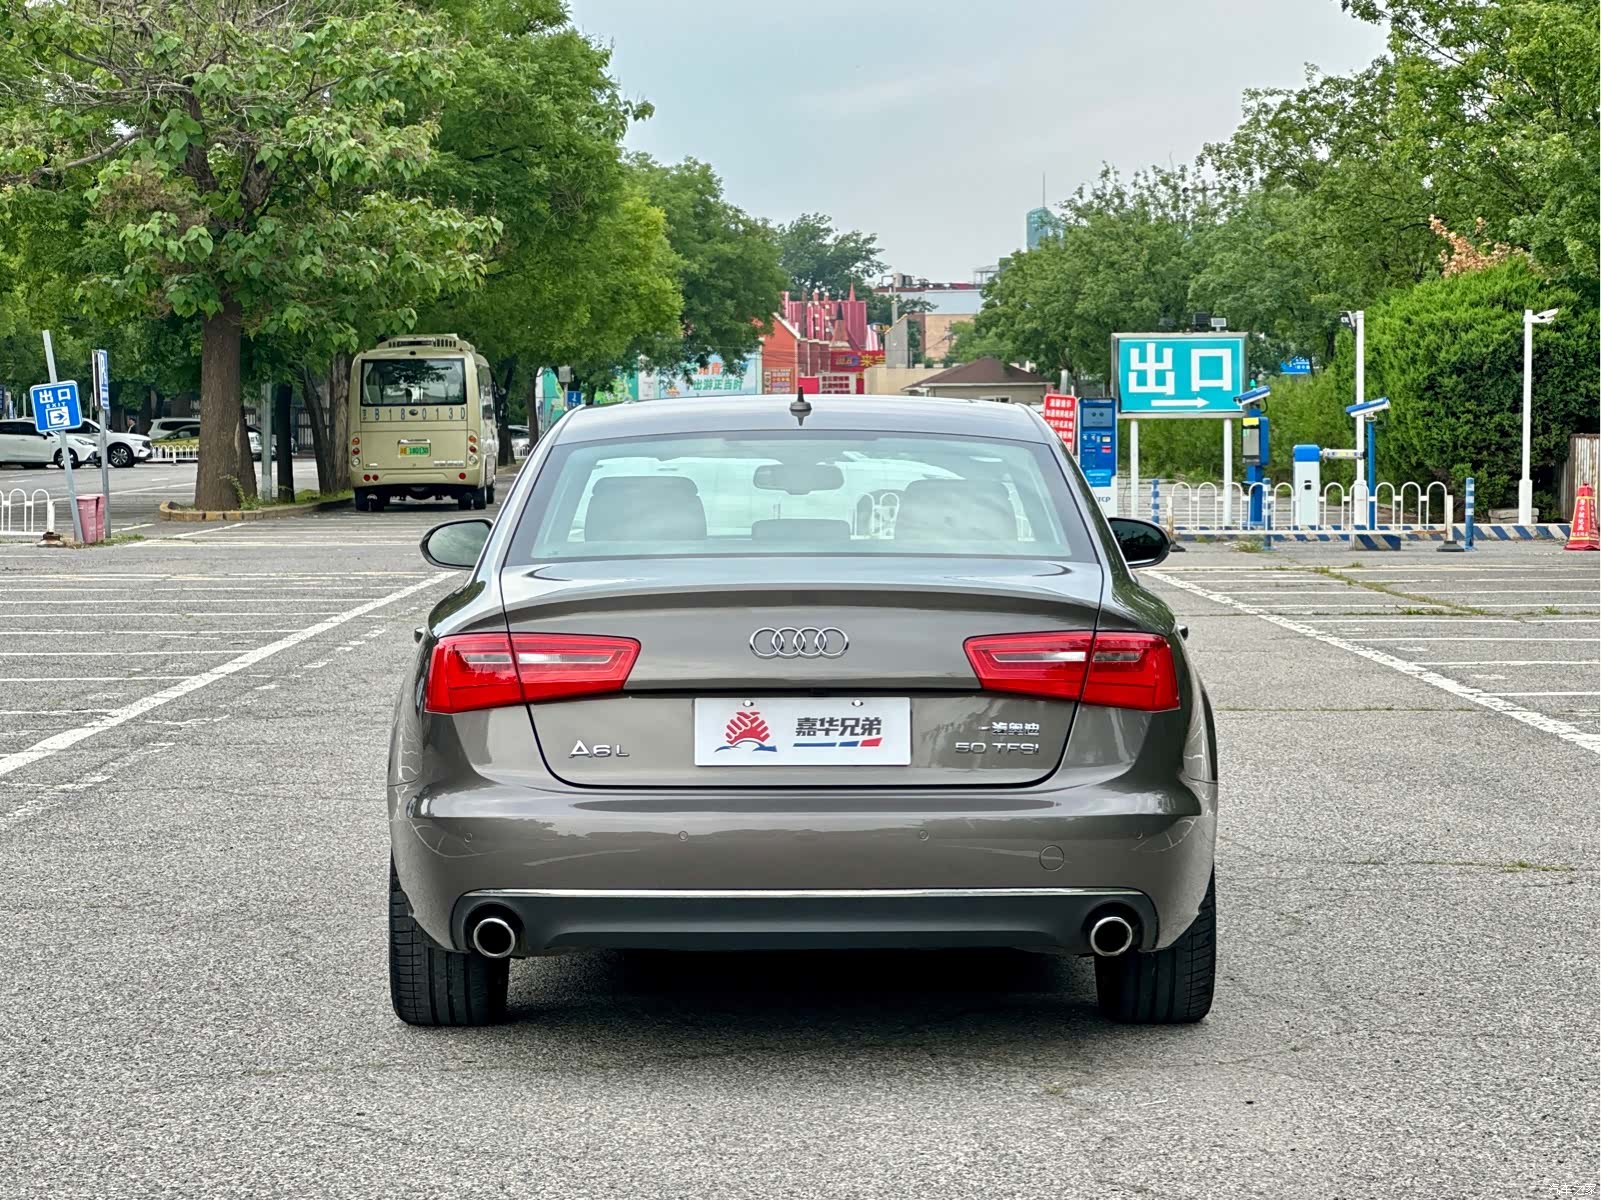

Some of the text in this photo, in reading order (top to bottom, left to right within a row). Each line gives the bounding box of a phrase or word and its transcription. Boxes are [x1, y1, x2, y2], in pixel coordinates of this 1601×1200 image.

[1128, 343, 1232, 395] 出口
[693, 378, 744, 391] 出游正当时
[39, 388, 71, 404] 出口
[795, 716, 882, 737] 嘉华兄弟
[955, 742, 1040, 755] 50 TFSI
